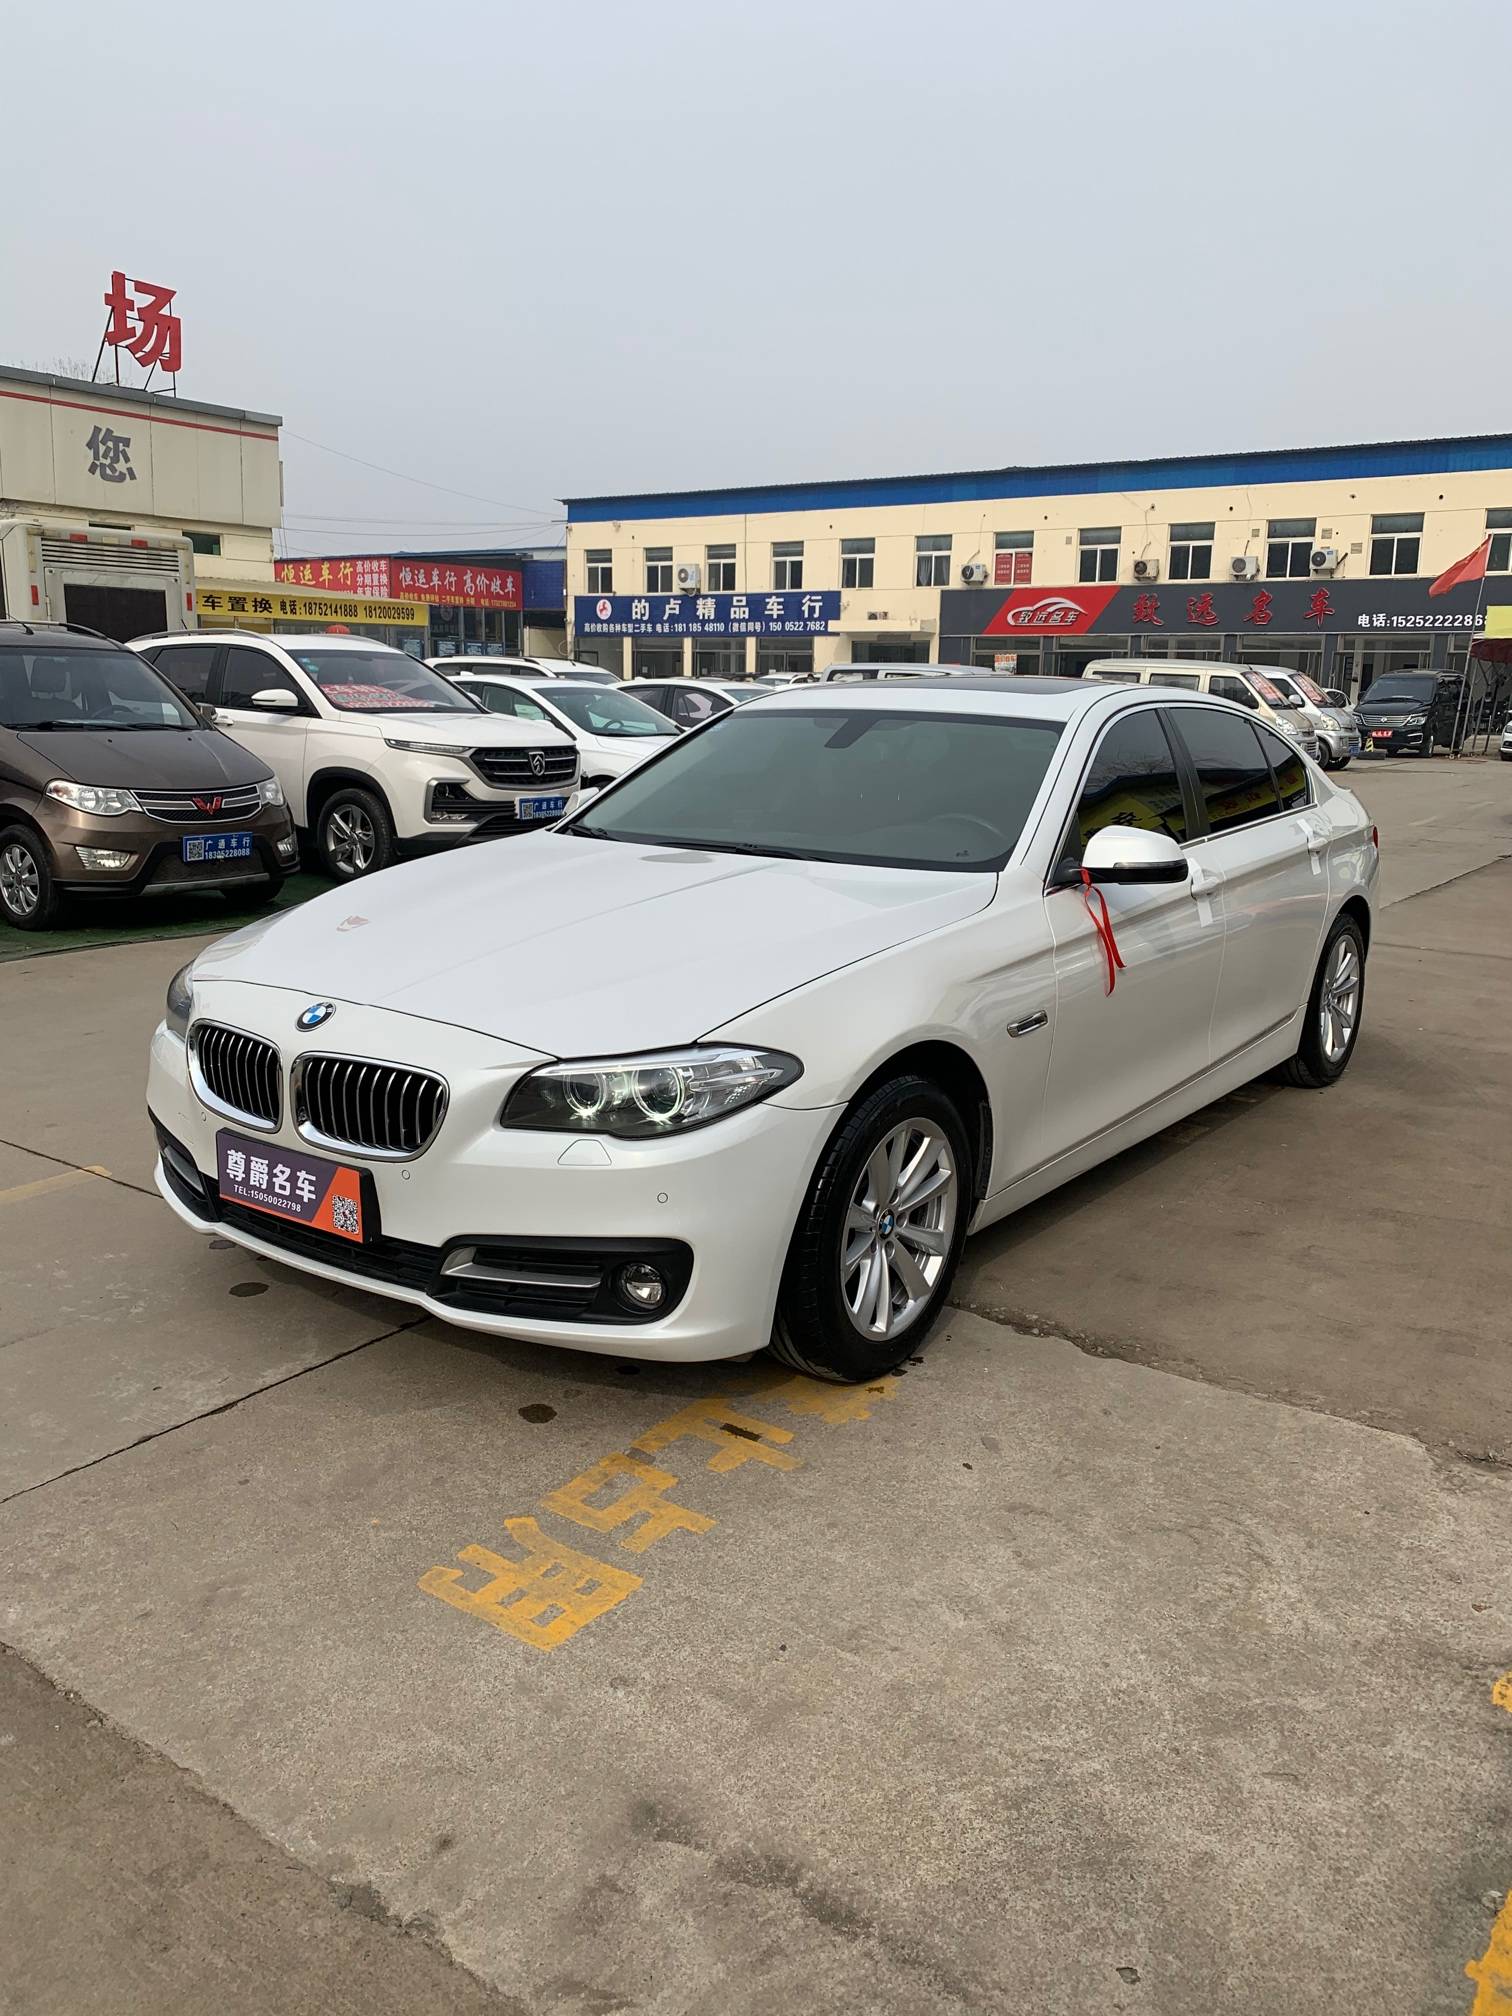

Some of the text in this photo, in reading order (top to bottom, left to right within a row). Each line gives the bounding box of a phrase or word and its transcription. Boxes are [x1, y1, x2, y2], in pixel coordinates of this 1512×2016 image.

[104, 271, 181, 372] 场
[86, 425, 137, 482] 您
[281, 561, 353, 588] 恒运车行
[356, 560, 388, 573] 高价收车
[399, 565, 516, 599] 恒运车行 高价收车
[202, 594, 273, 614] 车置换
[364, 605, 415, 620] 18120029599
[631, 594, 823, 621] 的卢精品车行
[1357, 613, 1487, 627] 电话:1525222286
[689, 622, 702, 633] 185
[704, 622, 724, 632] 48110
[769, 622, 782, 632] 150
[785, 622, 804, 632] 0522
[806, 620, 825, 631] 7682
[205, 836, 250, 851] 广通车行
[226, 1148, 317, 1204] 尊爵名车
[233, 1183, 302, 1213] TEL:15050022798
